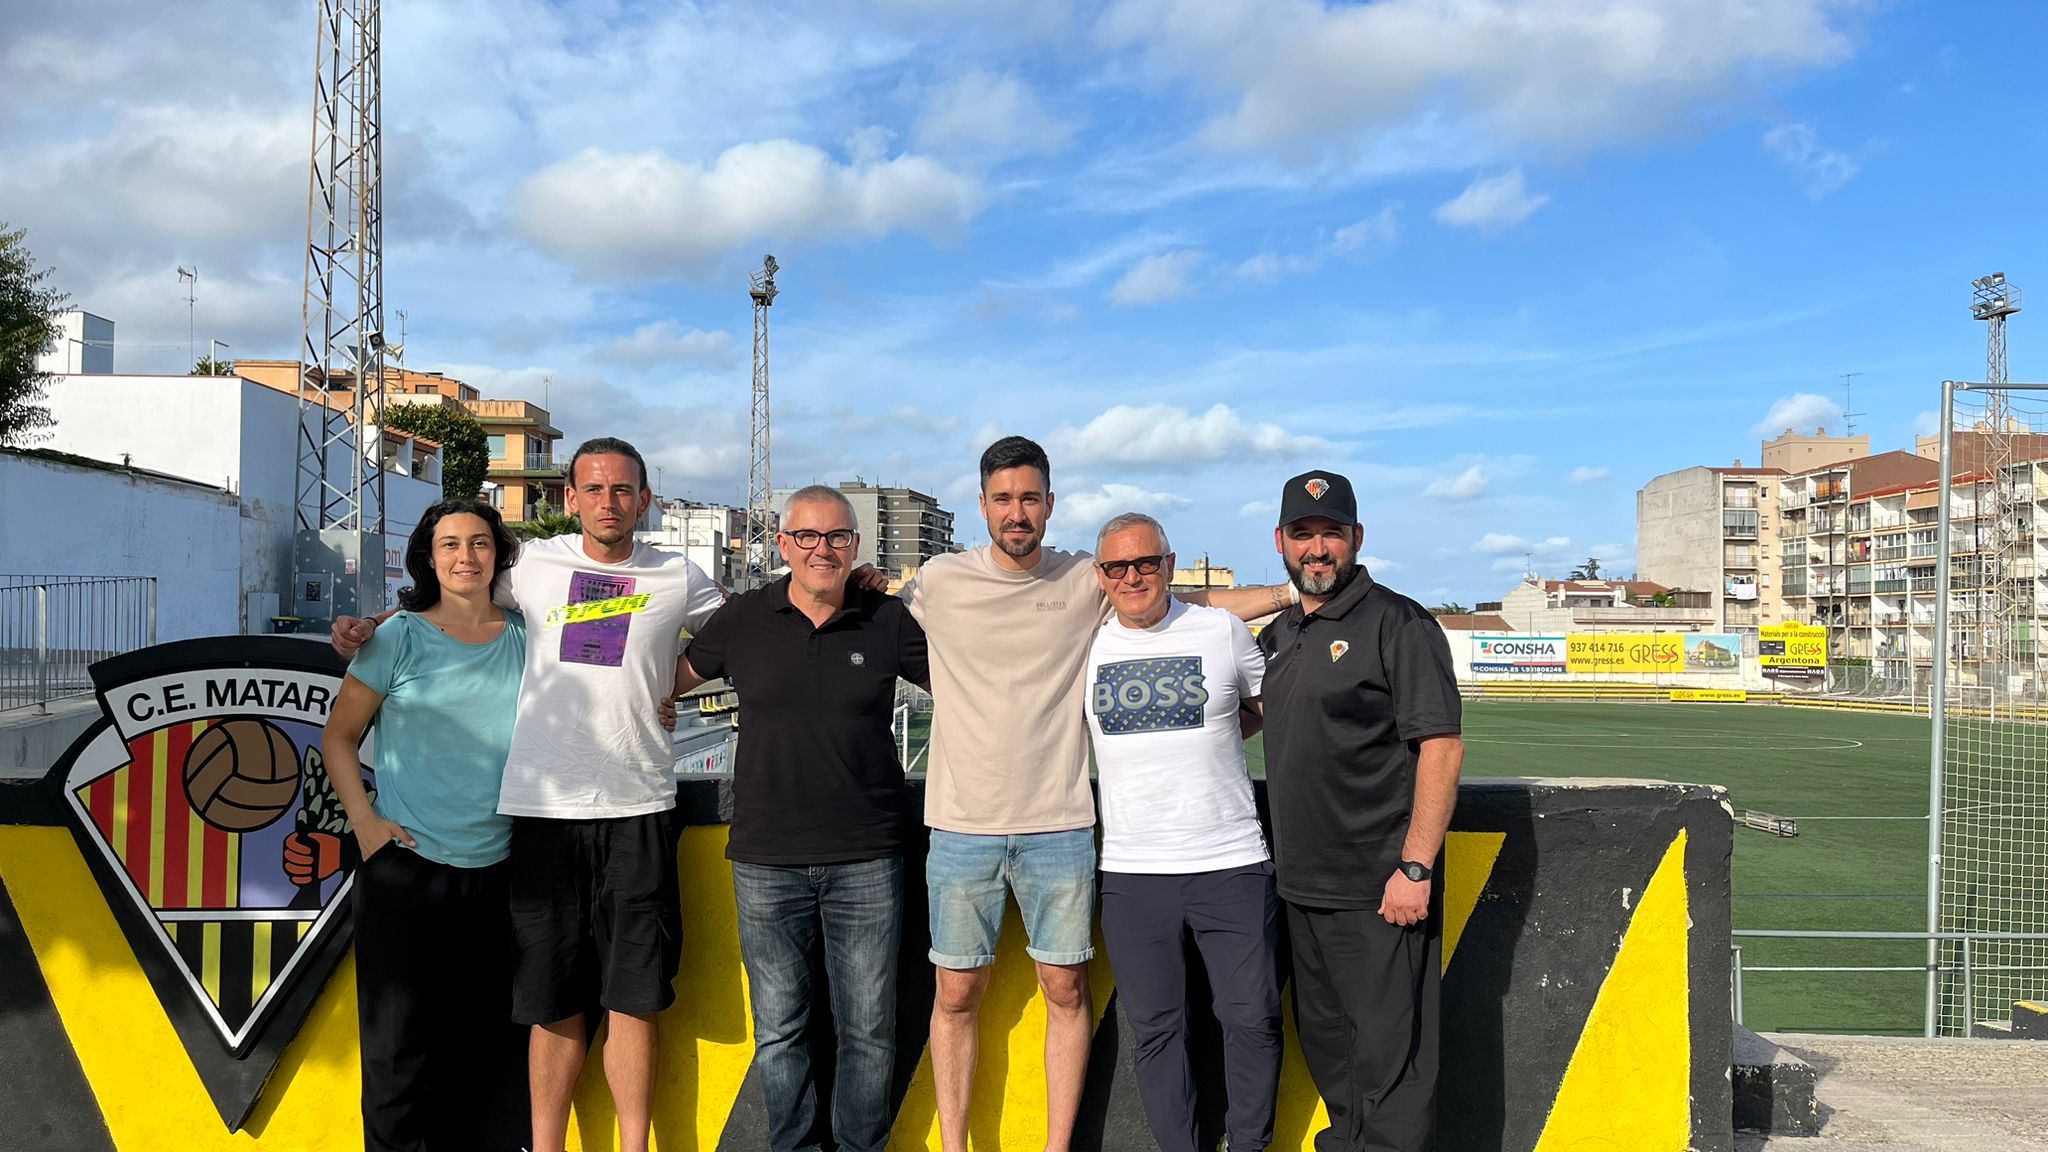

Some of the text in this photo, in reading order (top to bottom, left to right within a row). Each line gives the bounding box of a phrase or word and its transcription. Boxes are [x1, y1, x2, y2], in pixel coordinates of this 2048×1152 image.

[1493, 643, 1555, 655] CONSHA
[1570, 643, 1625, 652] 937 414 716
[1790, 643, 1821, 655] GRESS
[1630, 644, 1679, 664] GRESS
[1570, 657, 1625, 666] www.gress.es
[1769, 657, 1819, 665] Argentona
[127, 678, 336, 722] C.E. MATAR
[1093, 675, 1208, 714] BOSS
[1673, 690, 1694, 699] GRESS
